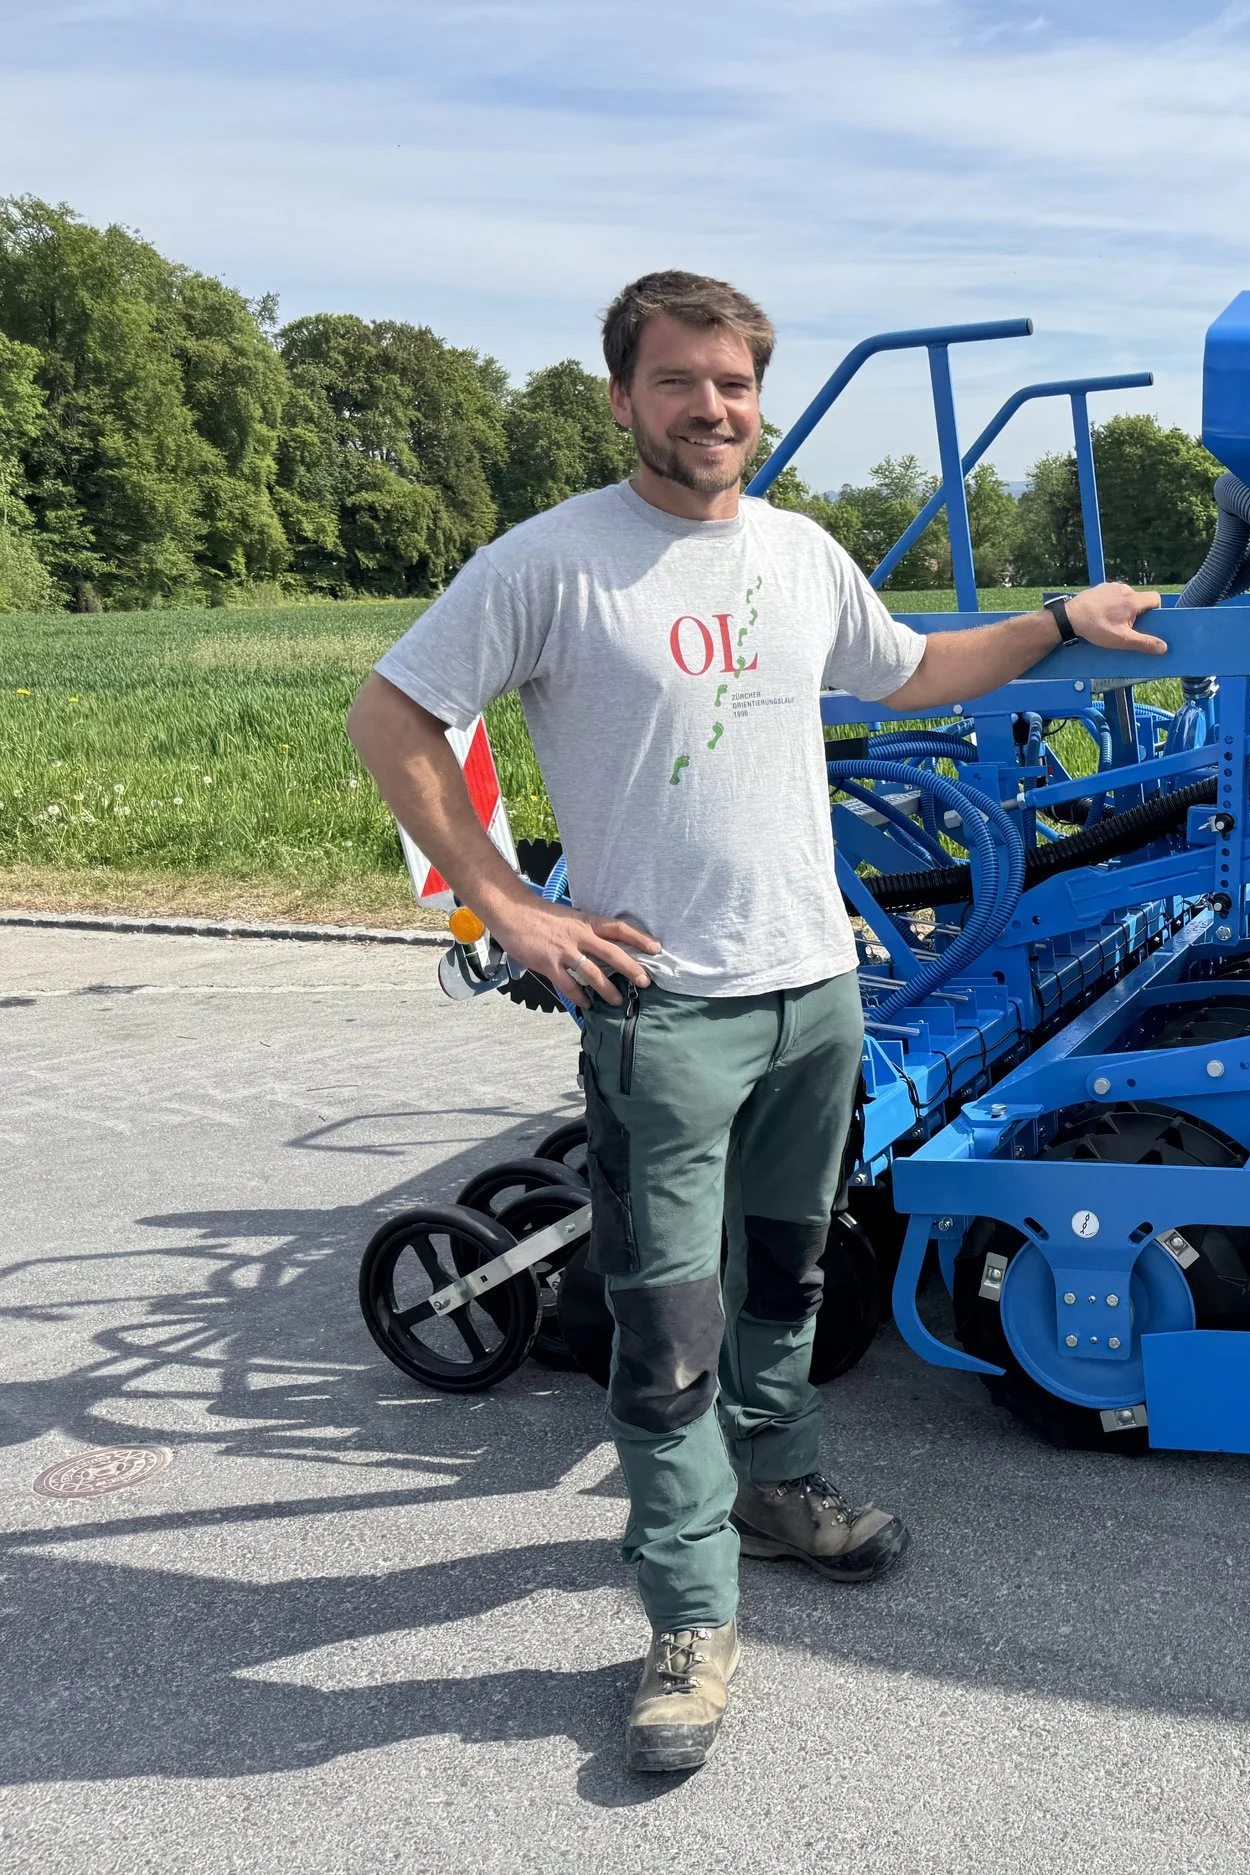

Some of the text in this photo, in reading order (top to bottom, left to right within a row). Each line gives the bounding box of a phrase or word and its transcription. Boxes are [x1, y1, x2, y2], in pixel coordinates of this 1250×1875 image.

[669, 613, 758, 677] OL
[731, 691, 761, 701] ZÜRCHER
[732, 696, 796, 709] ORIENTIERUNGSLAUF
